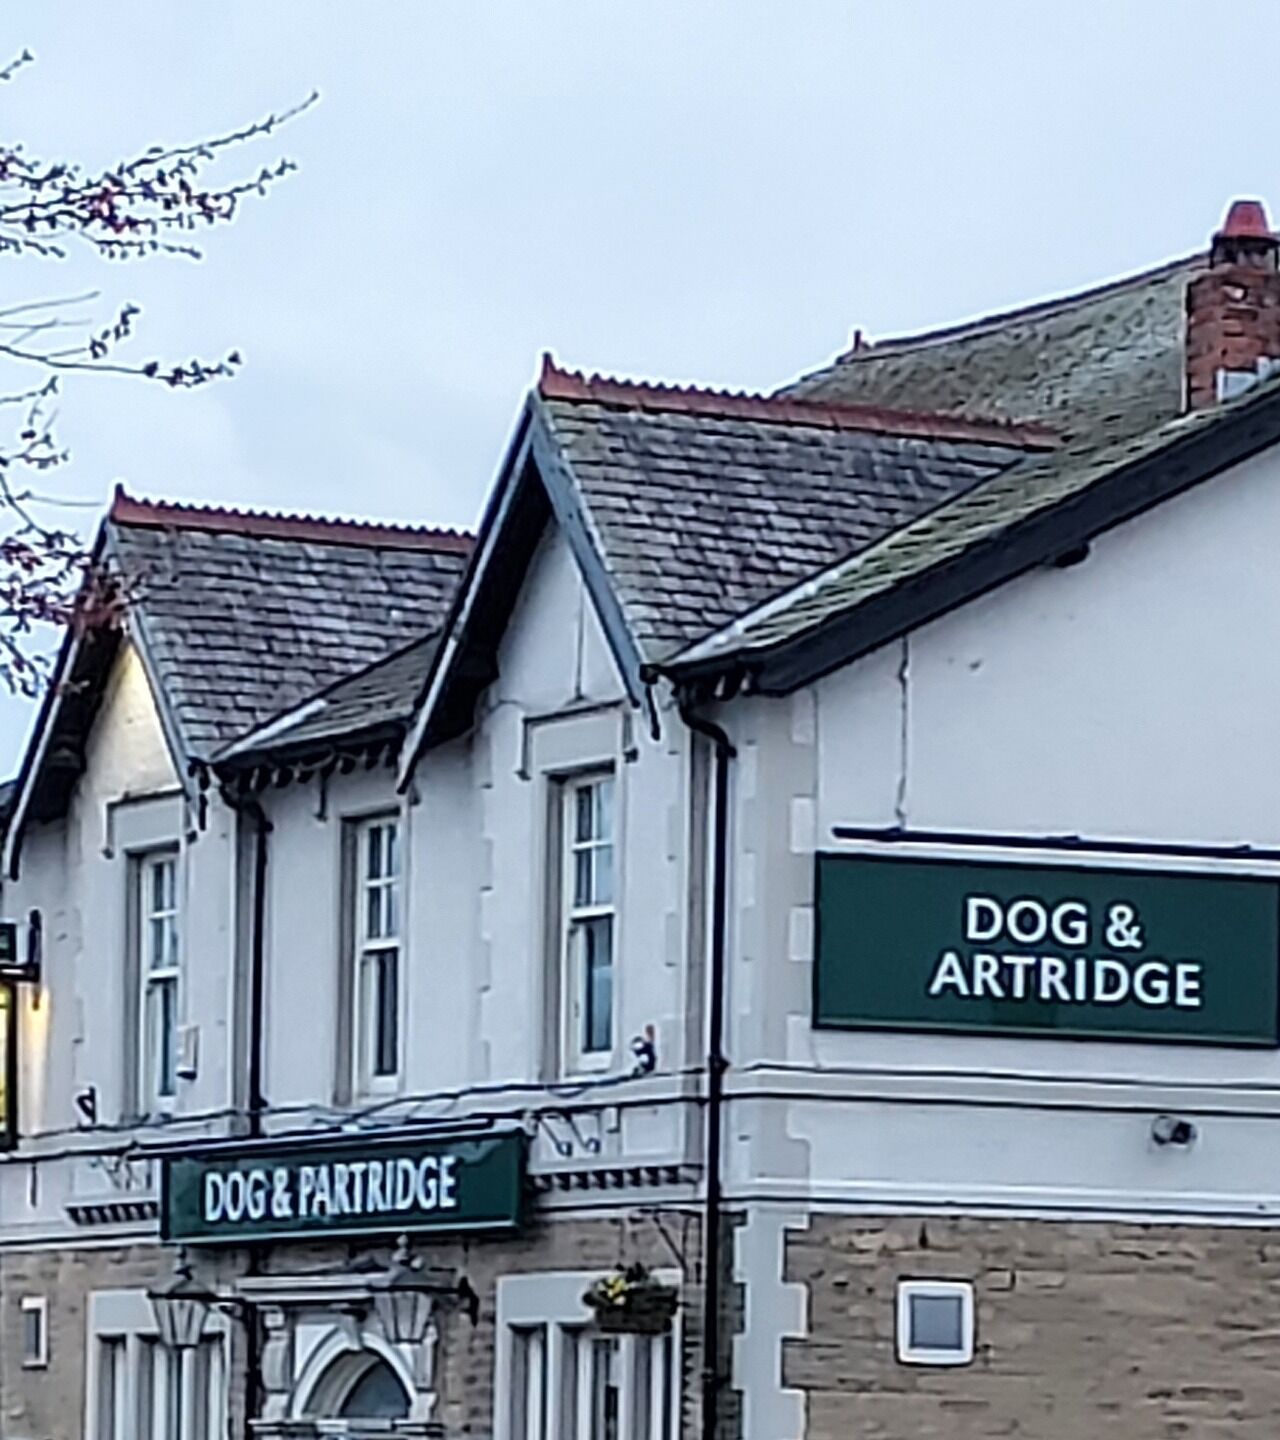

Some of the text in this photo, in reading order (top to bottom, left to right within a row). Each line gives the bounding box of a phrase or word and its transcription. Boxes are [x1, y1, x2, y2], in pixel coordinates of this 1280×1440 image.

[966, 897, 1142, 948] DOG &
[929, 952, 1201, 1006] ARTRIDGE
[204, 1155, 457, 1222] DOG & PARTRIDGE
